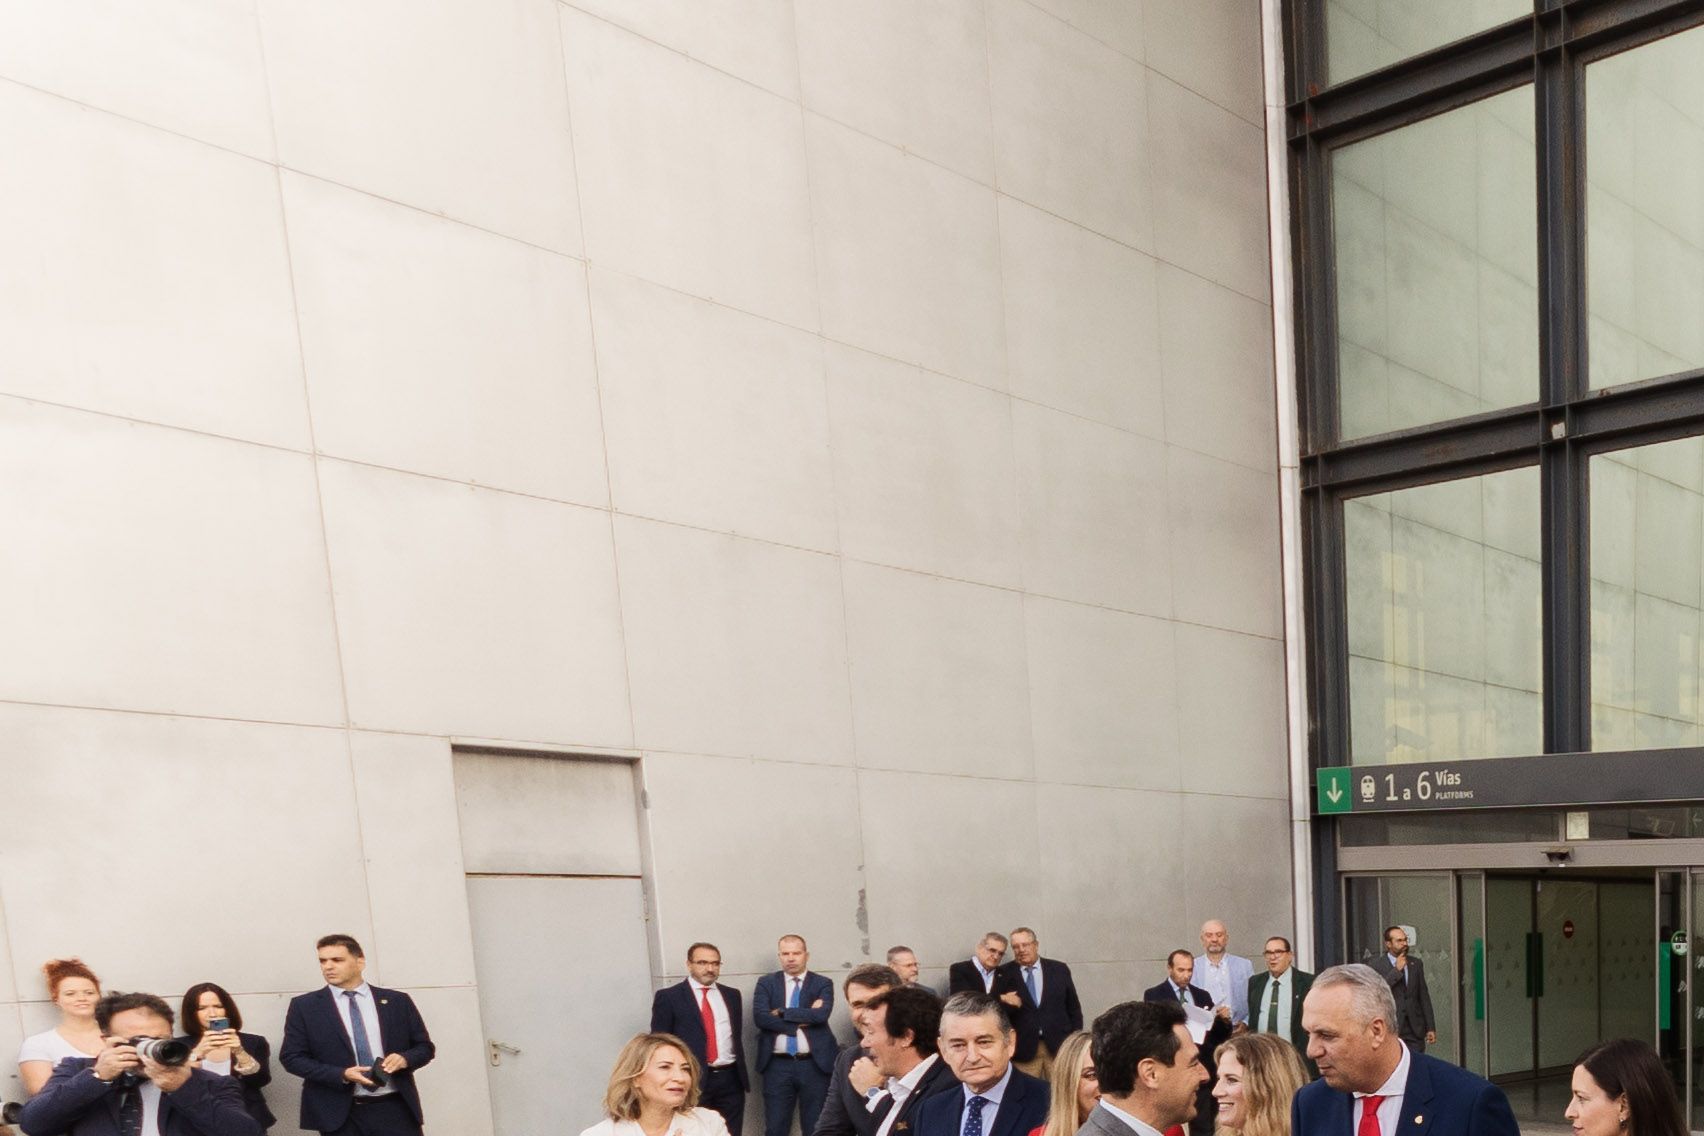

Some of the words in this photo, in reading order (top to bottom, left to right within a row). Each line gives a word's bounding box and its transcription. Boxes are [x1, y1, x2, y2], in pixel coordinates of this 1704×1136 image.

[1385, 773, 1399, 801] 1
[1402, 788, 1412, 800] a
[1417, 771, 1432, 800] 6
[1435, 769, 1461, 786] Vías
[1435, 790, 1474, 800] PLATFORMS
